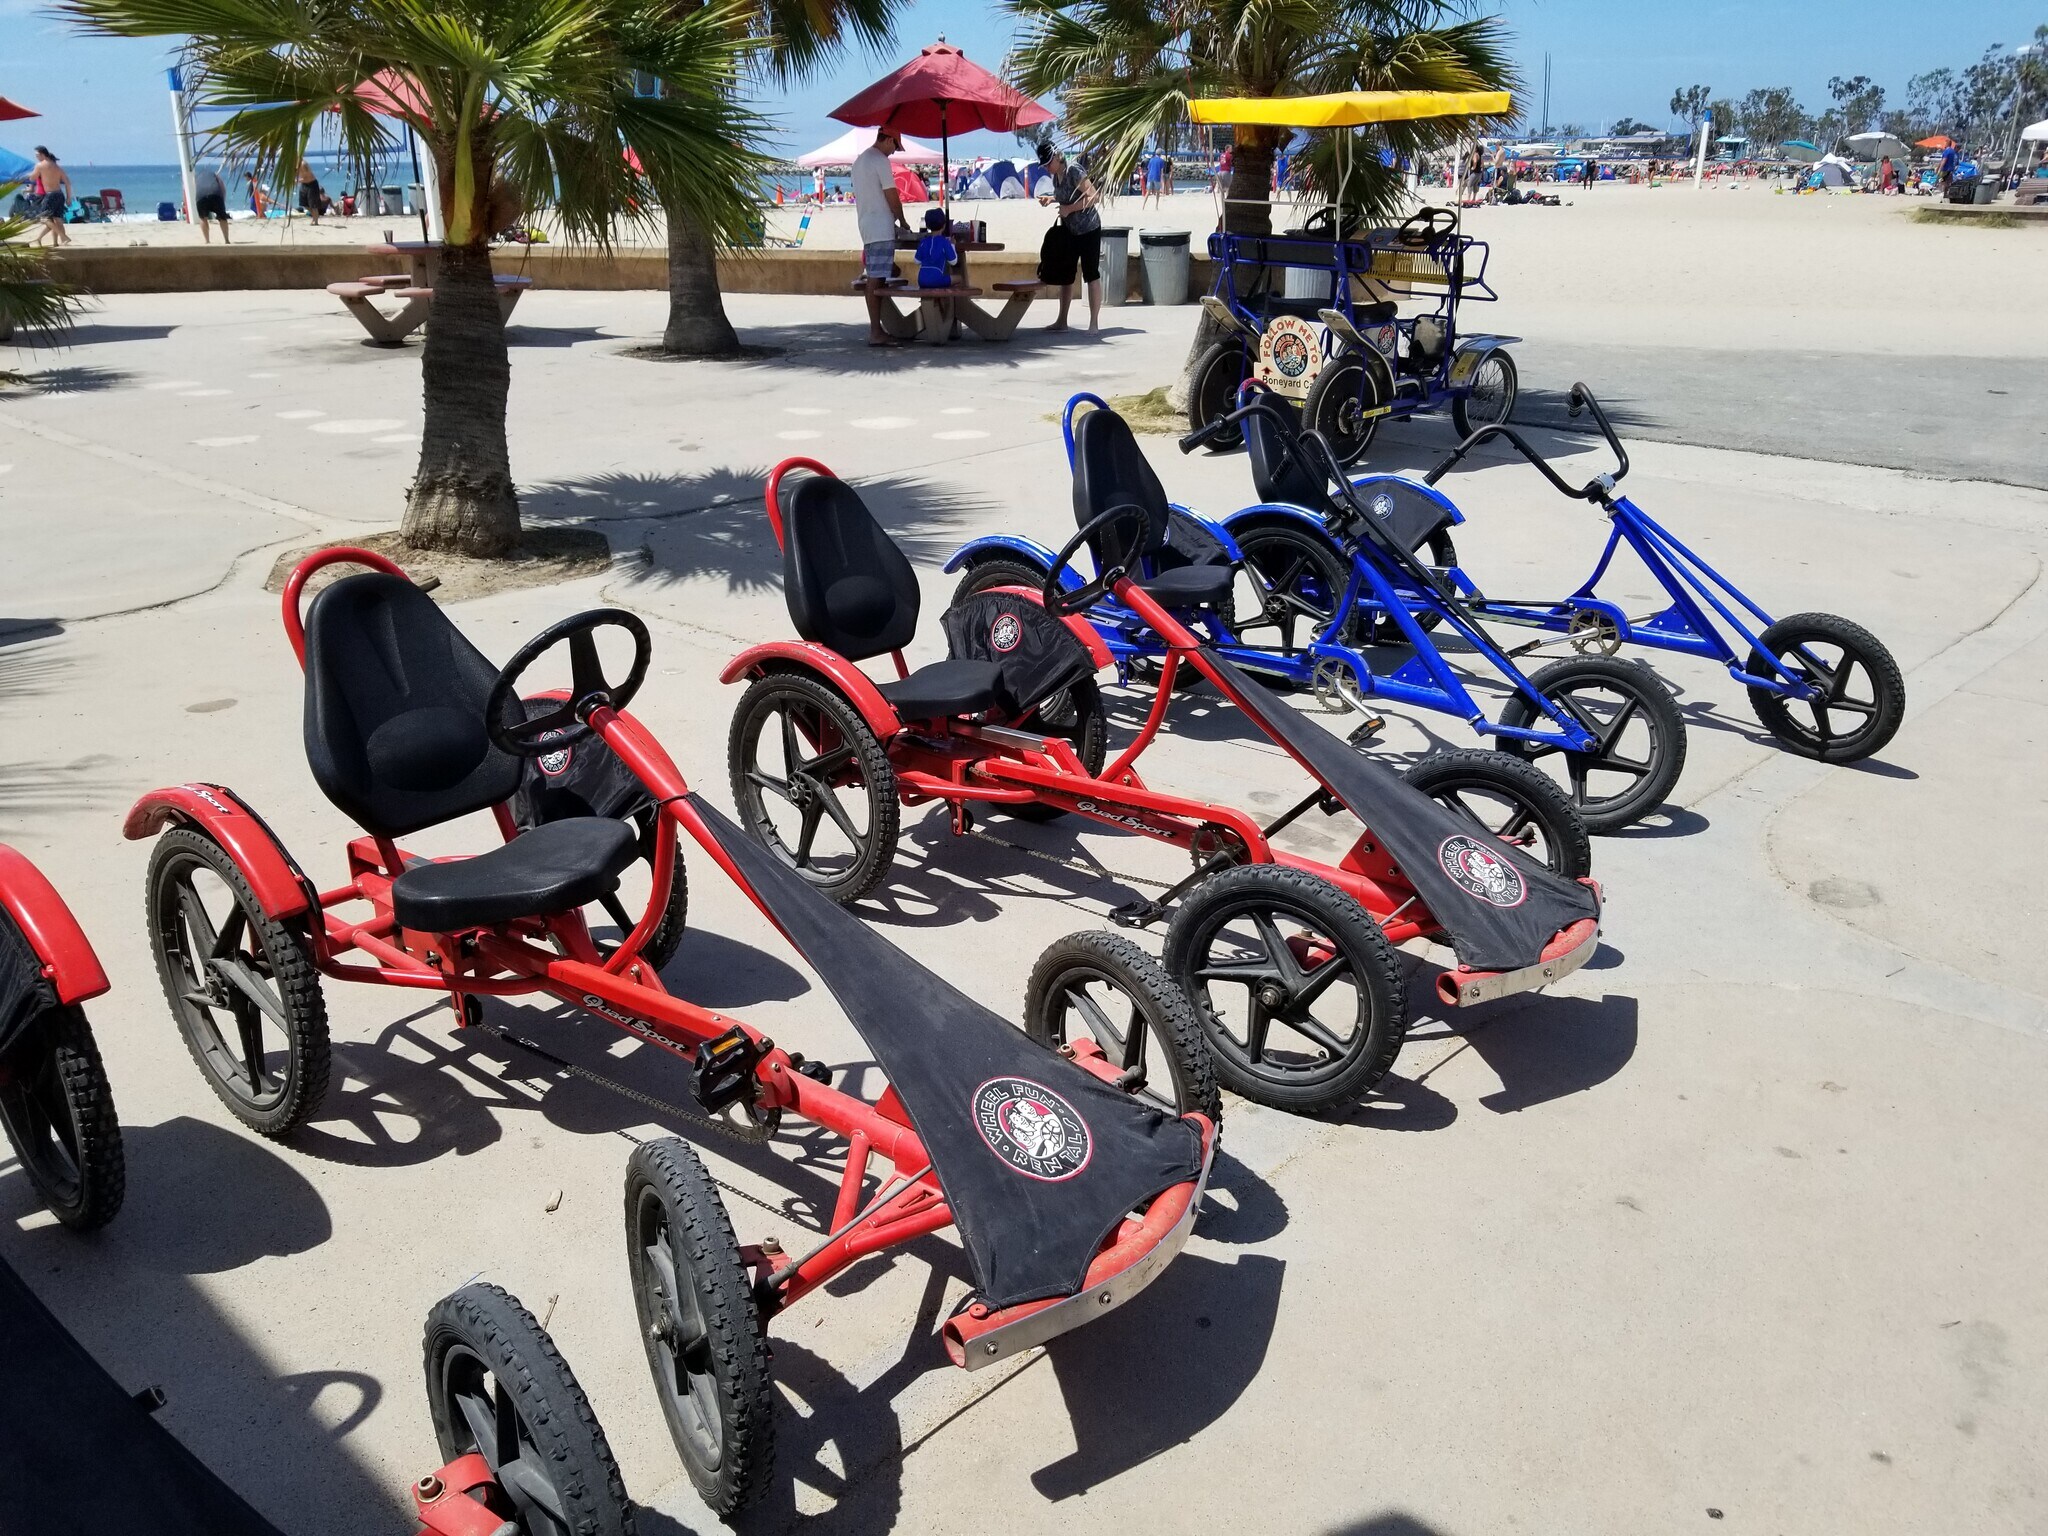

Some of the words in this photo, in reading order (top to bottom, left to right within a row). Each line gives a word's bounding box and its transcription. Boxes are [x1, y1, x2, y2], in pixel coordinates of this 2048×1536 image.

[1263, 320, 1295, 358] FOLLOW
[1298, 325, 1313, 343] ME
[1310, 345, 1318, 364] TO
[1262, 375, 1301, 389] Boneyard
[1077, 801, 1124, 822] Quad
[1122, 817, 1173, 838] Sport
[1472, 867, 1518, 903] RNTALS
[582, 994, 635, 1025] Quad
[631, 1020, 687, 1052] Sport
[981, 1087, 1009, 1145] WHEEL
[1011, 1083, 1056, 1108] FUN
[1013, 1117, 1083, 1173] RENTALS
